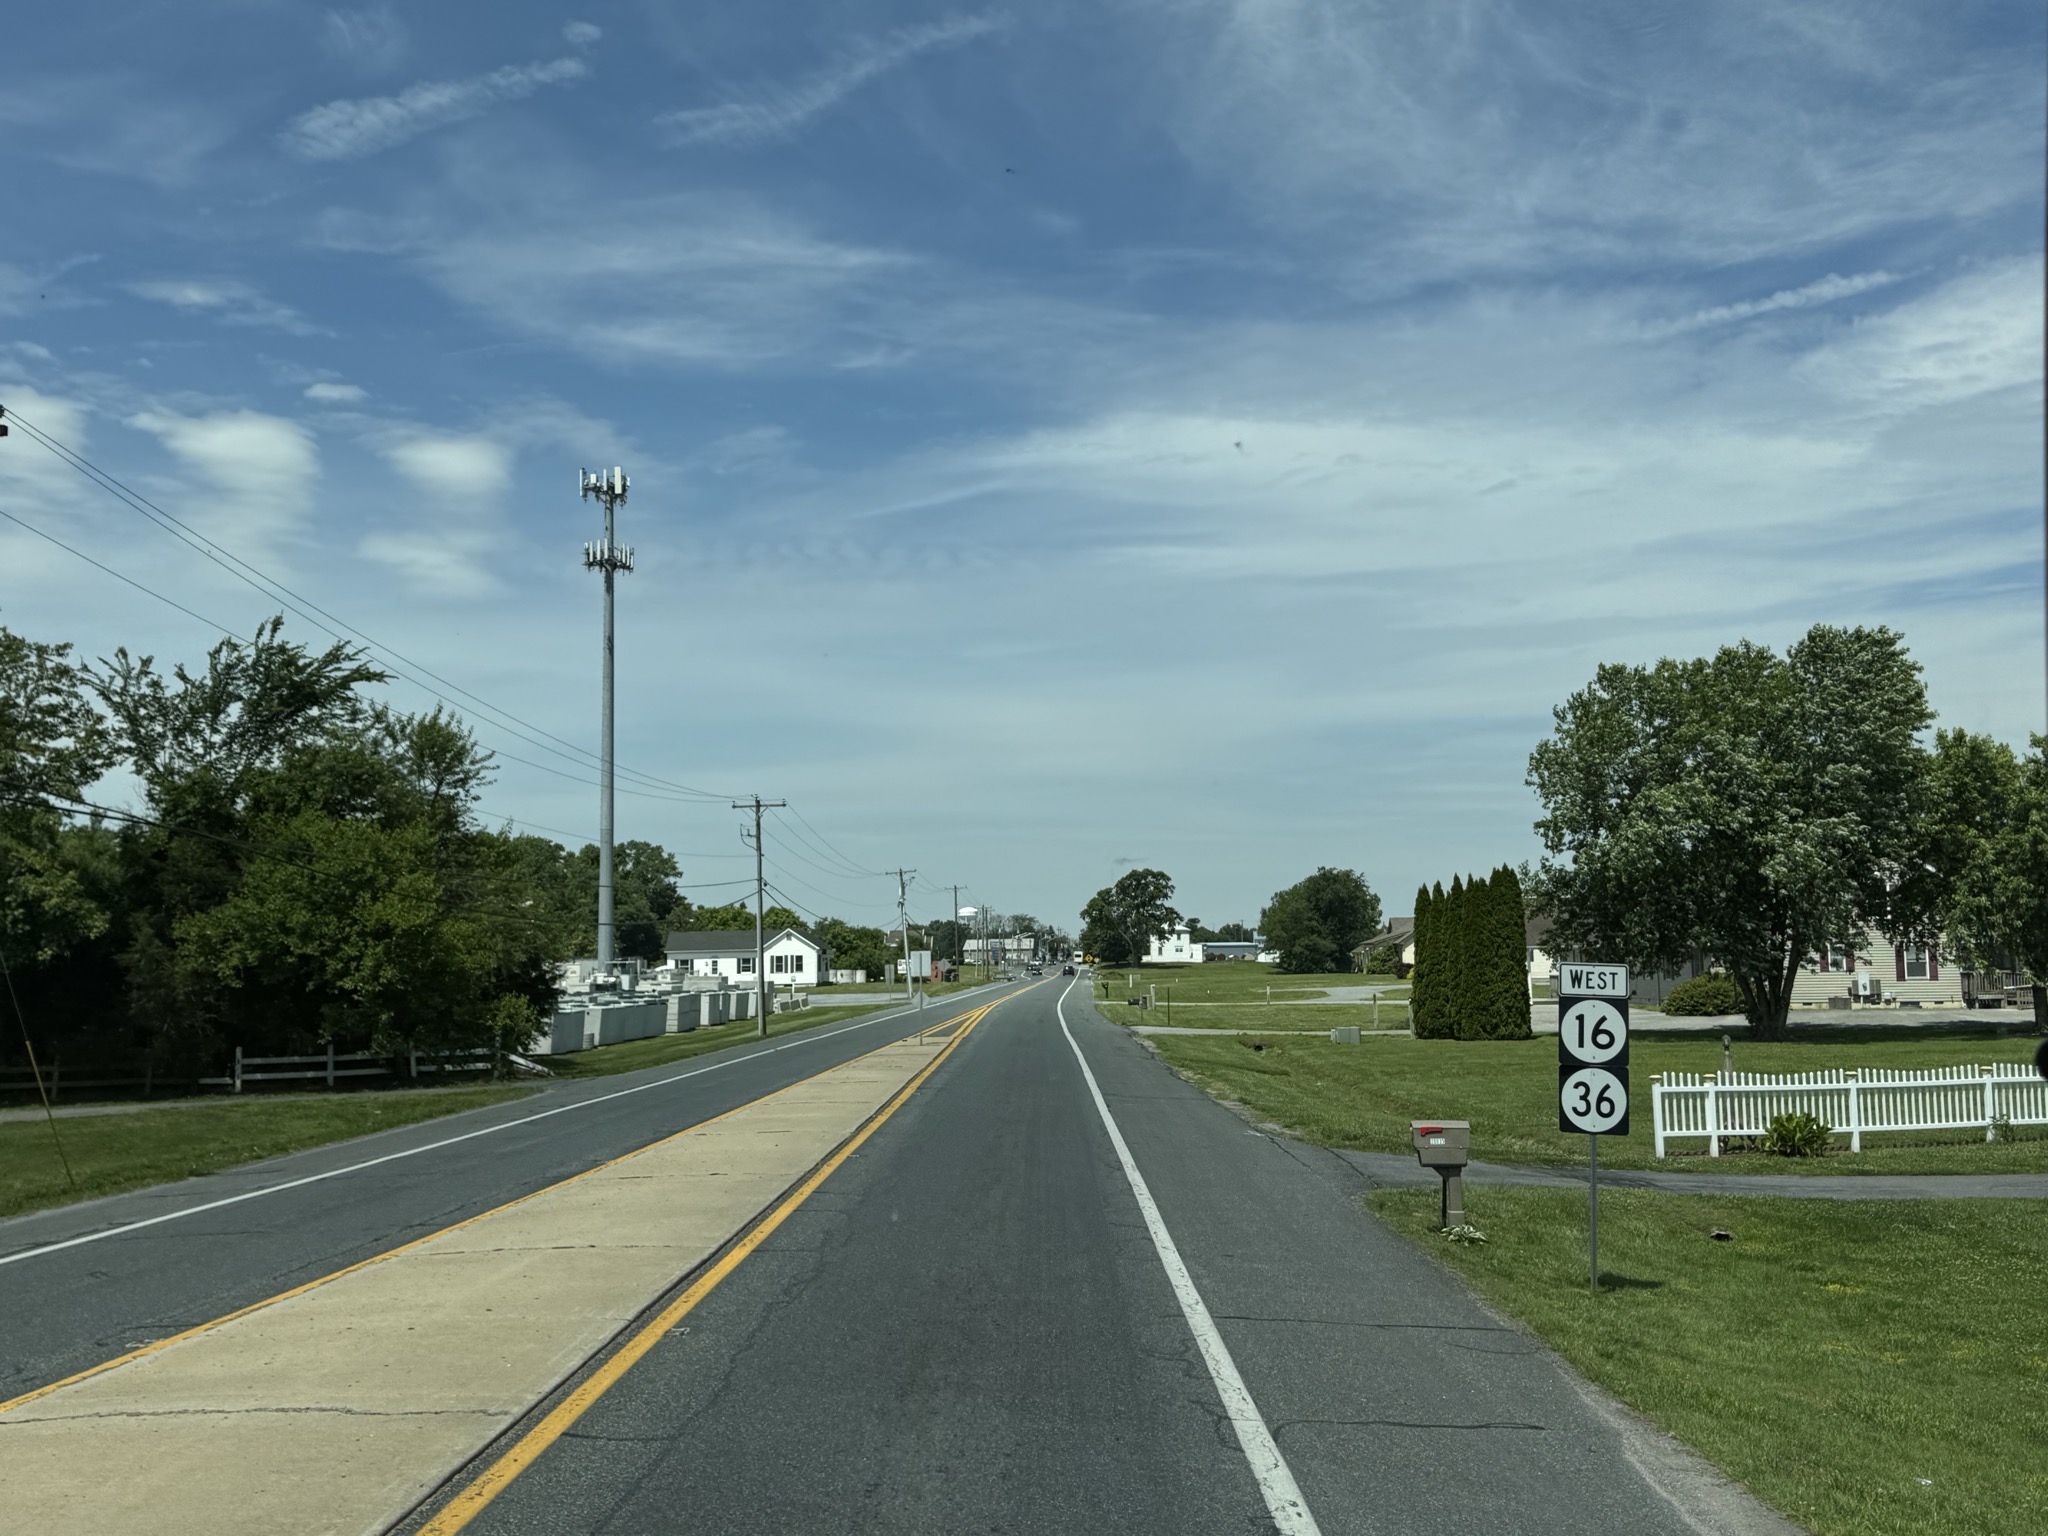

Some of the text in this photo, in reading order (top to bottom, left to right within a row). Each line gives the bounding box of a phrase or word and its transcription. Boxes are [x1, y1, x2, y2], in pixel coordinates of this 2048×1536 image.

[1569, 969, 1619, 990] WEST
[1575, 1013, 1616, 1050] 16
[1571, 1081, 1616, 1119] 36
